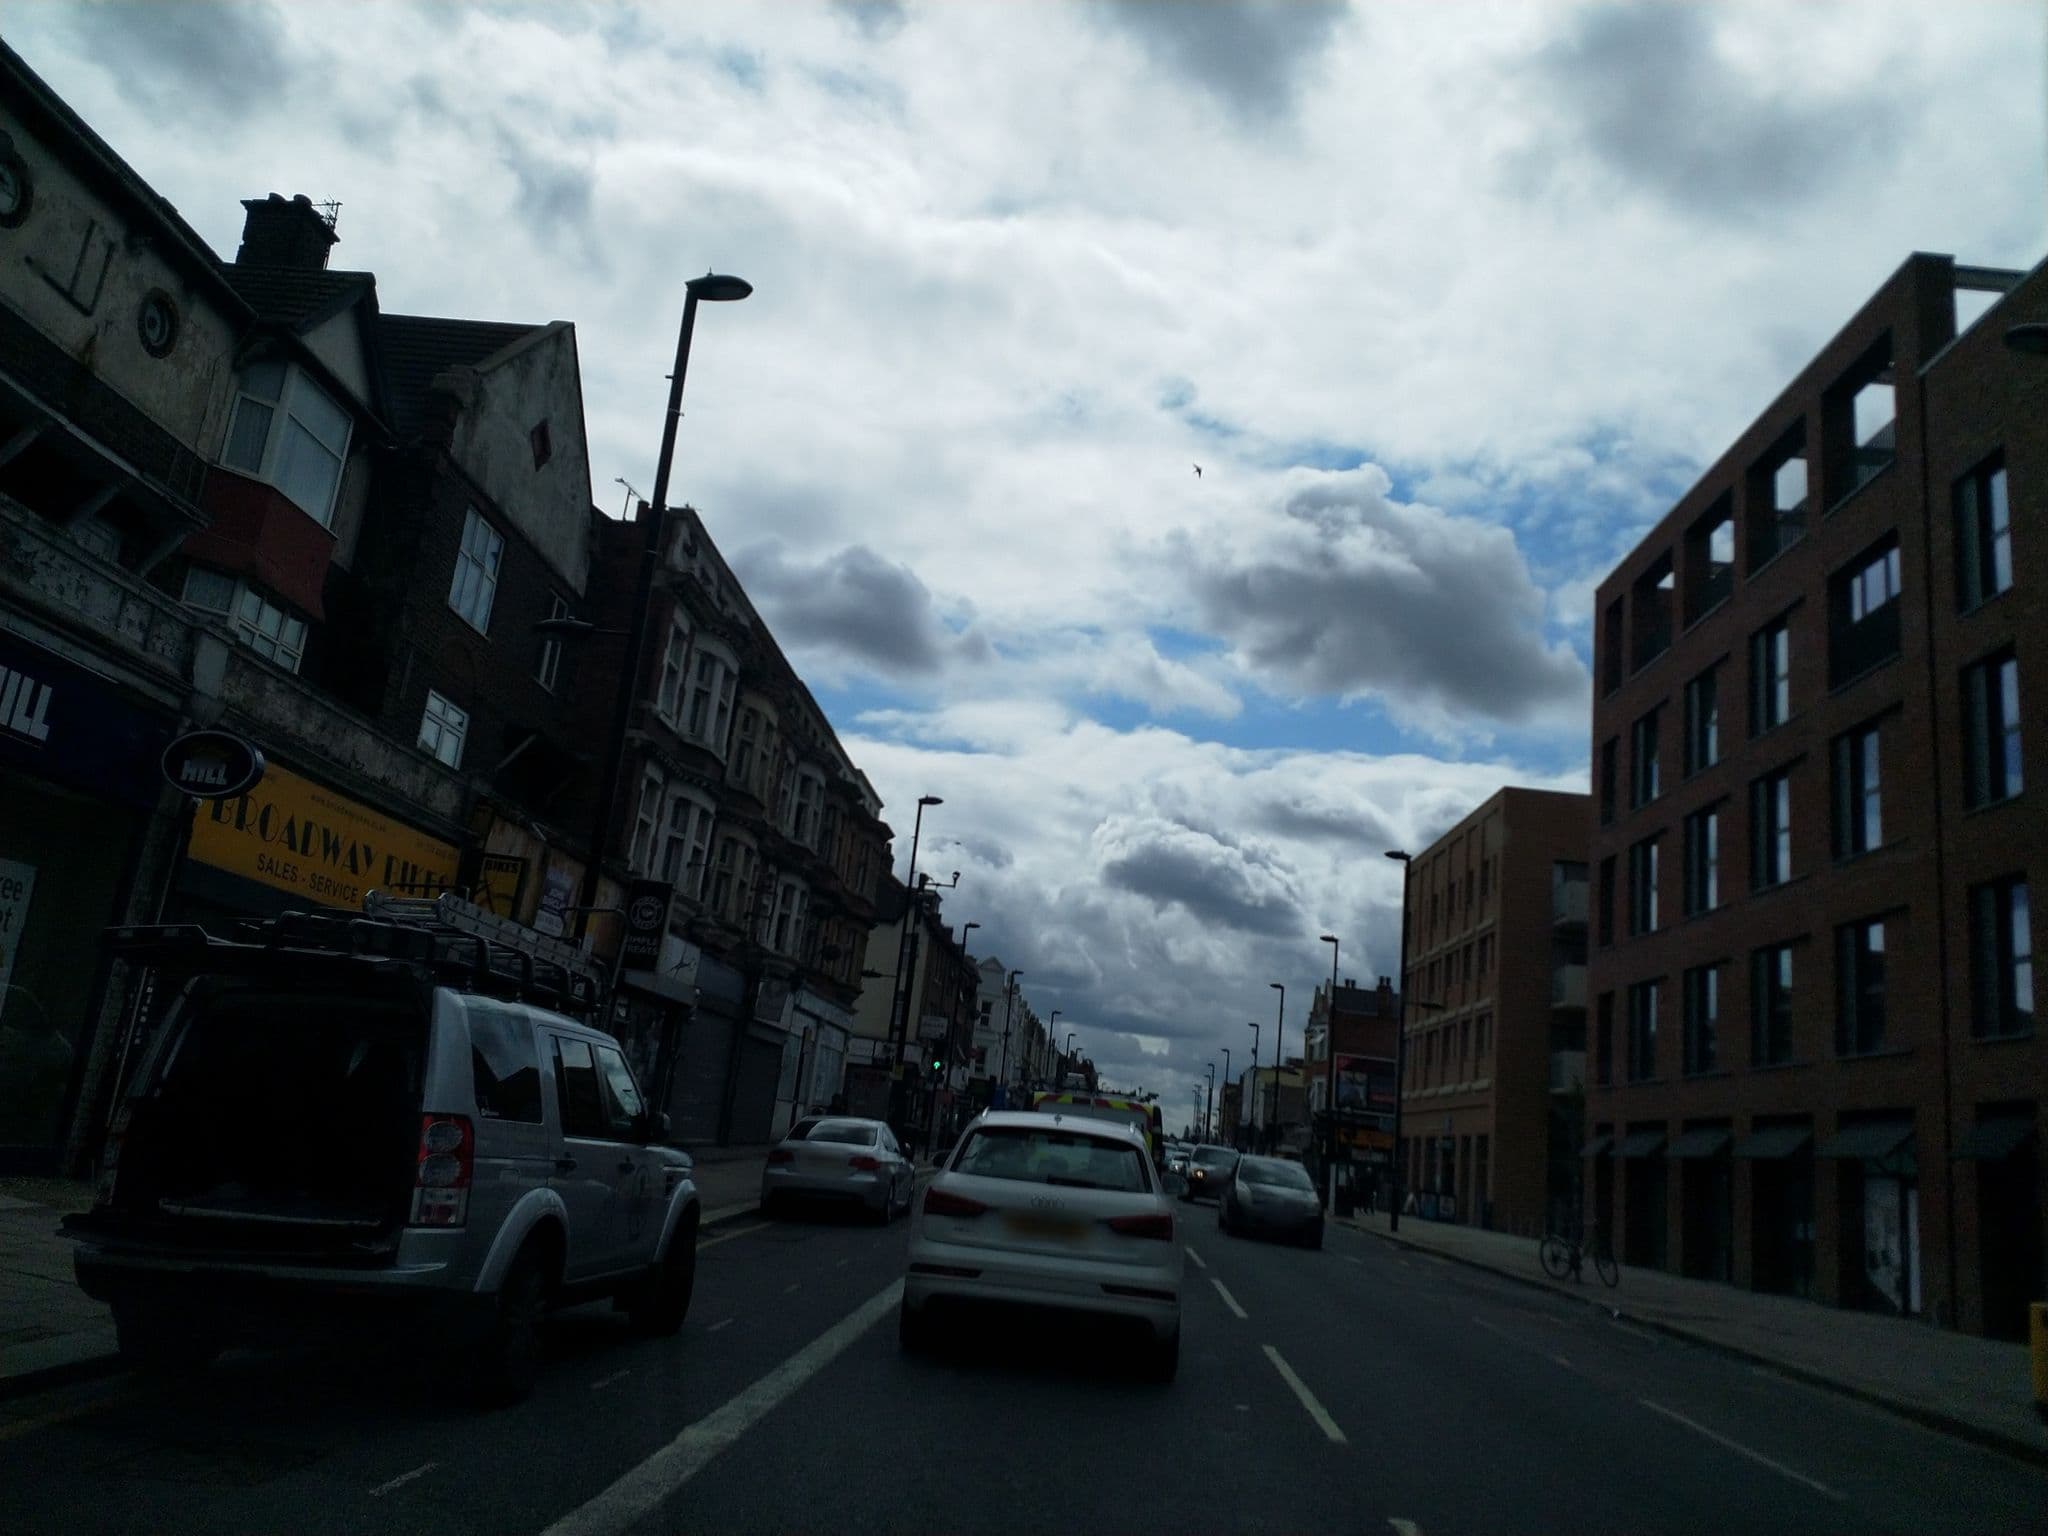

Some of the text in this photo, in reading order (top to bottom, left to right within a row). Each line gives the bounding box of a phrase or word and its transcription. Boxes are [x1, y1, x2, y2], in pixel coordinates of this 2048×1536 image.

[0, 664, 53, 742] ILL
[211, 796, 376, 878] BROADWAY
[257, 853, 359, 904] SALES SERVICE
